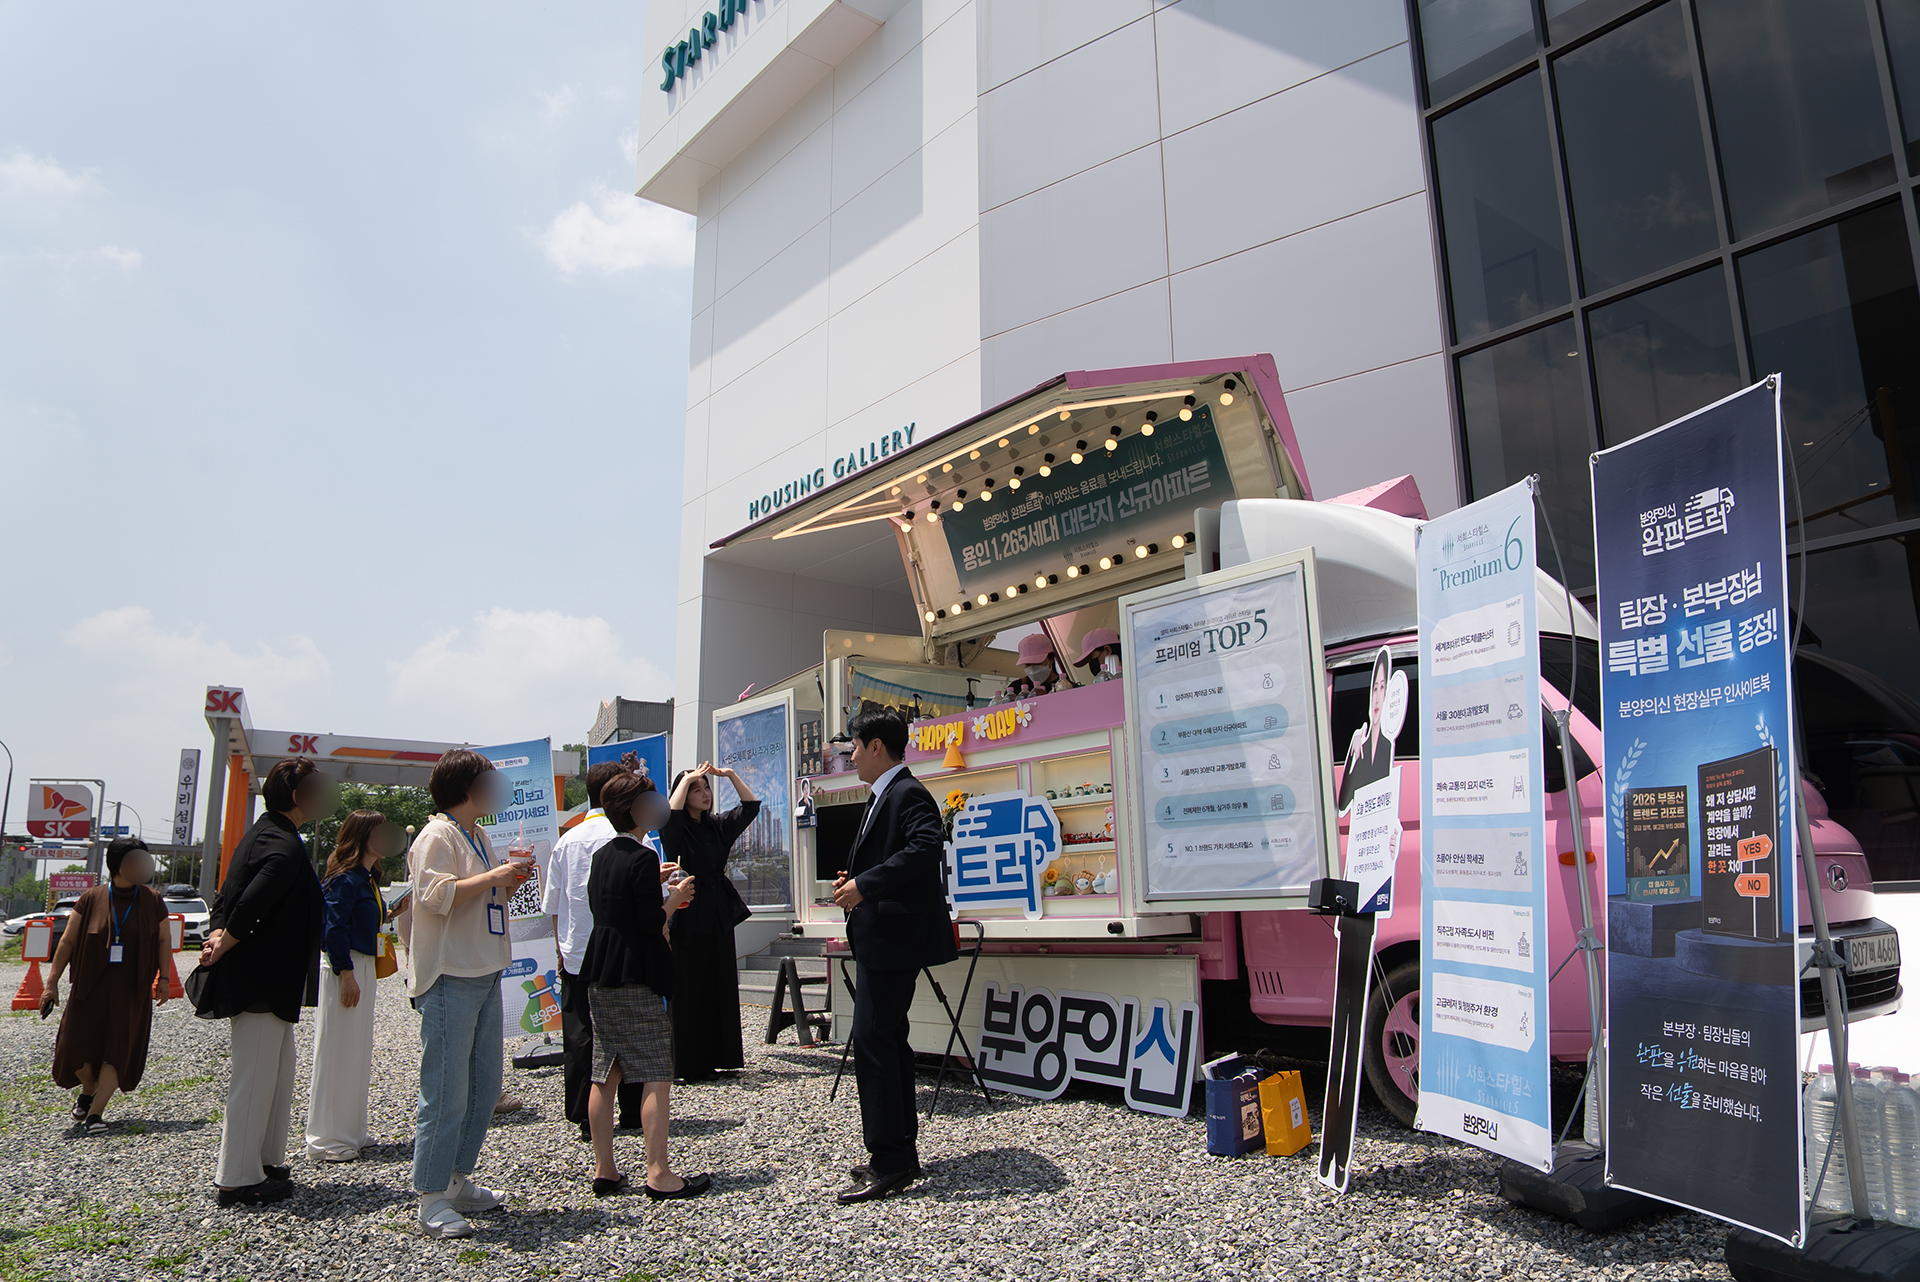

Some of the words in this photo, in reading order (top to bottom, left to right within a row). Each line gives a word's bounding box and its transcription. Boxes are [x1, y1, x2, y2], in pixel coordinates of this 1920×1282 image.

[659, 0, 760, 92] STARH
[1154, 421, 1213, 453] 서희스타힐스
[1167, 441, 1206, 463] STARHILLS
[749, 467, 824, 520] HOUSING
[833, 422, 916, 478] GALLERY
[982, 510, 1009, 531] 분양의신
[1045, 493, 1055, 507] 이
[1054, 485, 1080, 505] 맛있는
[1080, 473, 1107, 496] 음료를
[1107, 453, 1164, 484] 보내드립니다.
[962, 540, 992, 571] 용인
[991, 515, 1060, 561] 1,265세대
[1060, 496, 1115, 537] 대단지
[1117, 460, 1211, 519] 신규아파트
[1640, 503, 1677, 528] 분양의신
[1457, 524, 1489, 543] 서희스타힐스
[1642, 504, 1729, 556] 완판트럭
[1440, 558, 1503, 591] Premium
[1505, 514, 1523, 571] 6
[1619, 594, 1667, 630] 팀장
[1683, 561, 1762, 618] 본부장님
[1155, 640, 1201, 664] 프리미엄
[1608, 634, 1669, 677] 특별
[1676, 619, 1735, 669] 선물
[1738, 607, 1778, 653] 증정!
[205, 689, 243, 714] SK
[1159, 694, 1163, 704] 1
[1619, 695, 1671, 718] 분양의신
[1673, 686, 1723, 713] 현장실무
[1724, 672, 1771, 704] 인사이트북
[1436, 711, 1447, 721] 서울
[919, 721, 963, 751] HAPPY
[985, 707, 1016, 740] DAY
[1161, 731, 1166, 741] 2
[288, 734, 319, 754] SK
[1163, 768, 1169, 778] 3
[525, 789, 544, 802] 보고
[1633, 793, 1656, 806] 2026
[1658, 791, 1684, 805] 부동산
[1706, 793, 1714, 807] 왜
[1716, 792, 1725, 805] 저
[1726, 785, 1756, 805] 상담사만
[174, 775, 193, 845] 우리설렁
[498, 805, 549, 823] 받아가세요!
[1165, 806, 1171, 815] 4
[1633, 808, 1659, 821] 트렌드
[1661, 806, 1685, 819] 리포트
[1707, 808, 1731, 823] 계약을
[1732, 805, 1752, 821] 쓸까?
[44, 822, 71, 836] SK
[1707, 825, 1739, 841] 현장에서
[31, 849, 81, 858] 내트럭플러스
[1168, 843, 1173, 853] 5
[1224, 841, 1254, 850] 서희스타힐스
[1707, 843, 1732, 857] 갈리는
[1743, 842, 1761, 855] YES
[1452, 853, 1466, 864] 안심
[1467, 854, 1485, 865] 학세권
[1708, 860, 1716, 874] 한
[1728, 860, 1743, 873] 차이
[1747, 879, 1761, 891] NO
[1455, 926, 1481, 939] 자족도시
[1482, 929, 1495, 940] 비전
[1877, 937, 1896, 963] 4669
[530, 1002, 561, 1028] 분양의
[1435, 997, 1458, 1010] 고급레저
[1483, 1005, 1499, 1018] 환경
[1663, 1020, 1696, 1039] 본부장
[1703, 1025, 1751, 1048] 팀장님들의
[978, 988, 1193, 1109] 분양의신
[1636, 1042, 1674, 1069] 완판을
[1677, 1047, 1717, 1075] 응원하는
[1718, 1060, 1749, 1081] 마음을
[1750, 1066, 1767, 1085] 담아
[1466, 1064, 1532, 1098] 서희스타힐스
[1477, 1089, 1519, 1114] STARHILLS
[1640, 1083, 1663, 1102] 작은
[1666, 1082, 1701, 1109] 선물을
[1702, 1093, 1763, 1123] 준비했습니다.
[1463, 1112, 1498, 1141] 분양의신
